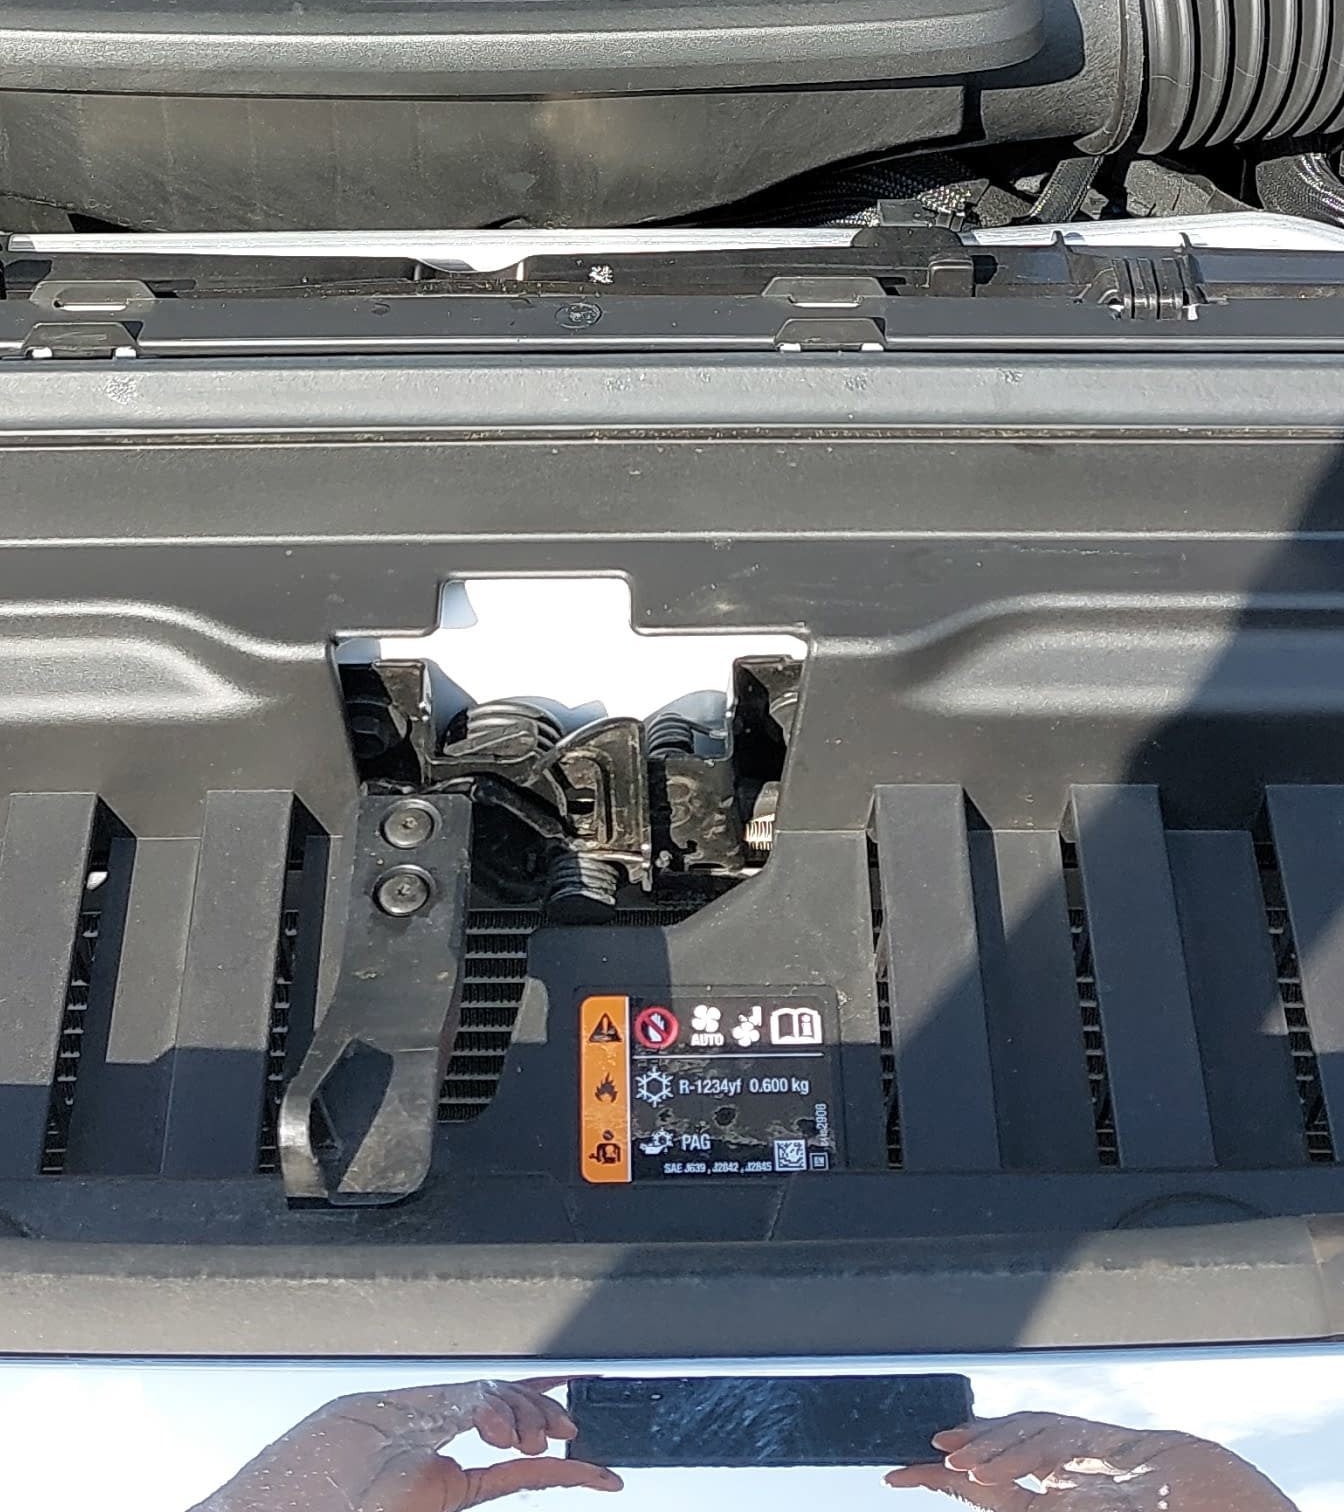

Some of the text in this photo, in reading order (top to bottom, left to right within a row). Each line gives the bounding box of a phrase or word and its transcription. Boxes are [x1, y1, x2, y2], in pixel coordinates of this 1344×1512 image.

[691, 1033, 724, 1046] AUTO
[679, 1077, 809, 1095] R-1234yf 0.600 kg
[681, 1134, 711, 1150] PAG
[664, 1162, 683, 1173] SAE
